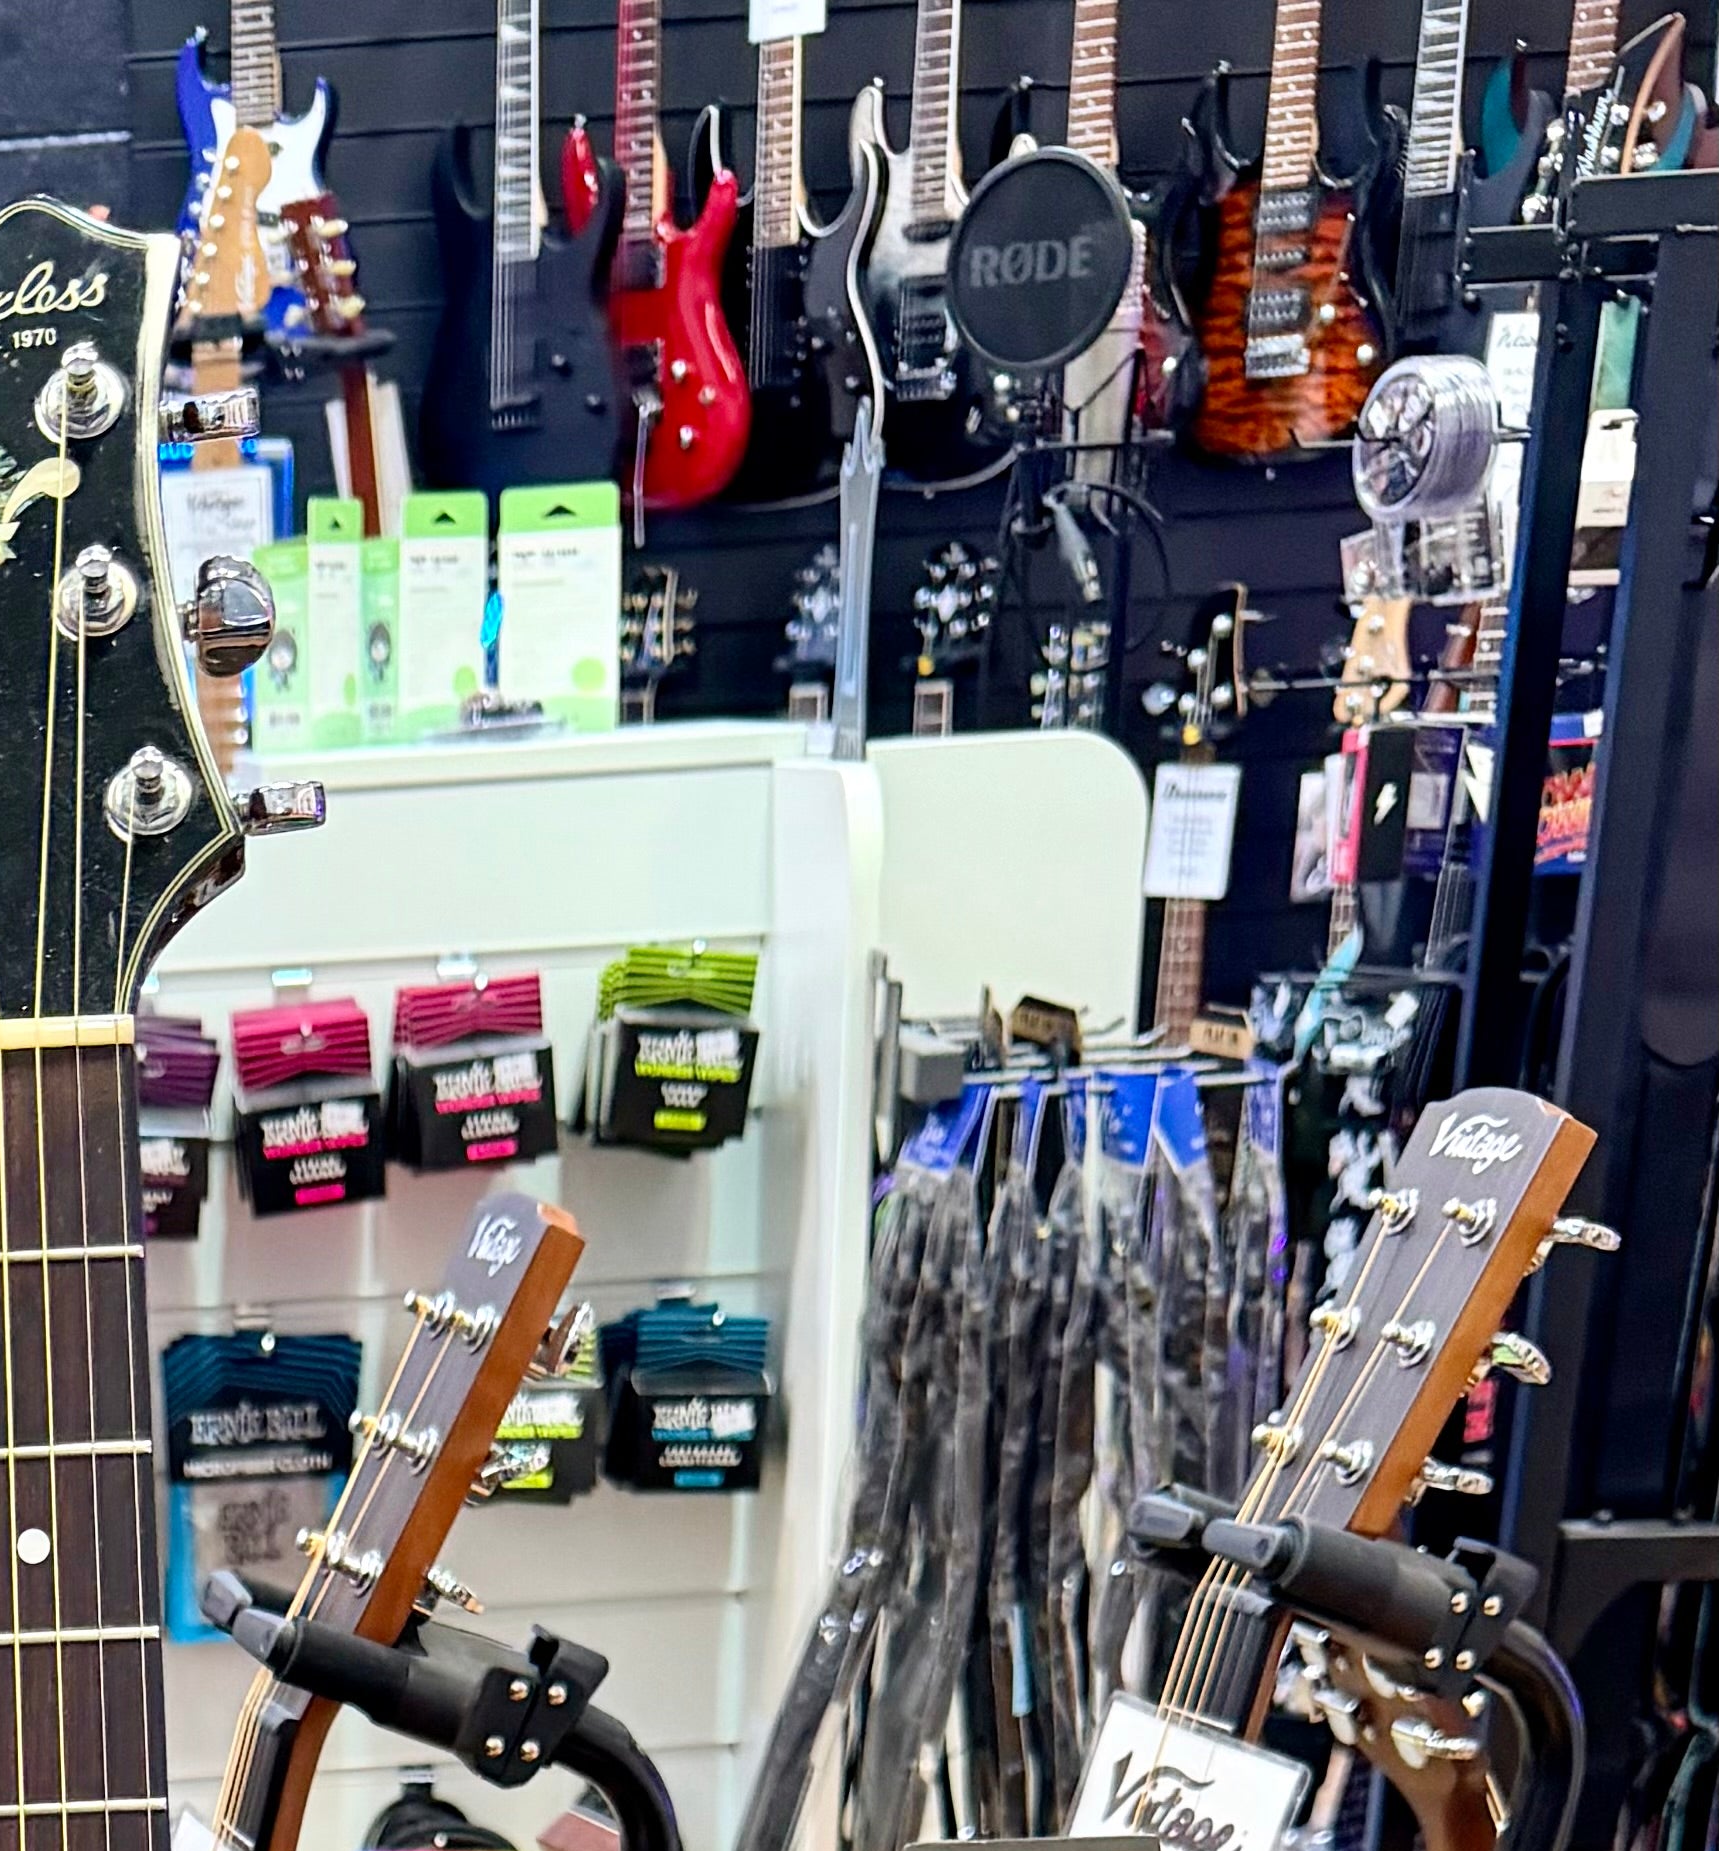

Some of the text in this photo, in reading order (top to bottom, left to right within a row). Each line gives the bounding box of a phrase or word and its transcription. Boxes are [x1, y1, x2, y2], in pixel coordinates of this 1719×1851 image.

[969, 234, 1096, 288] RØDE
[11, 327, 58, 350] 1970
[1428, 1112, 1524, 1175] Vintage
